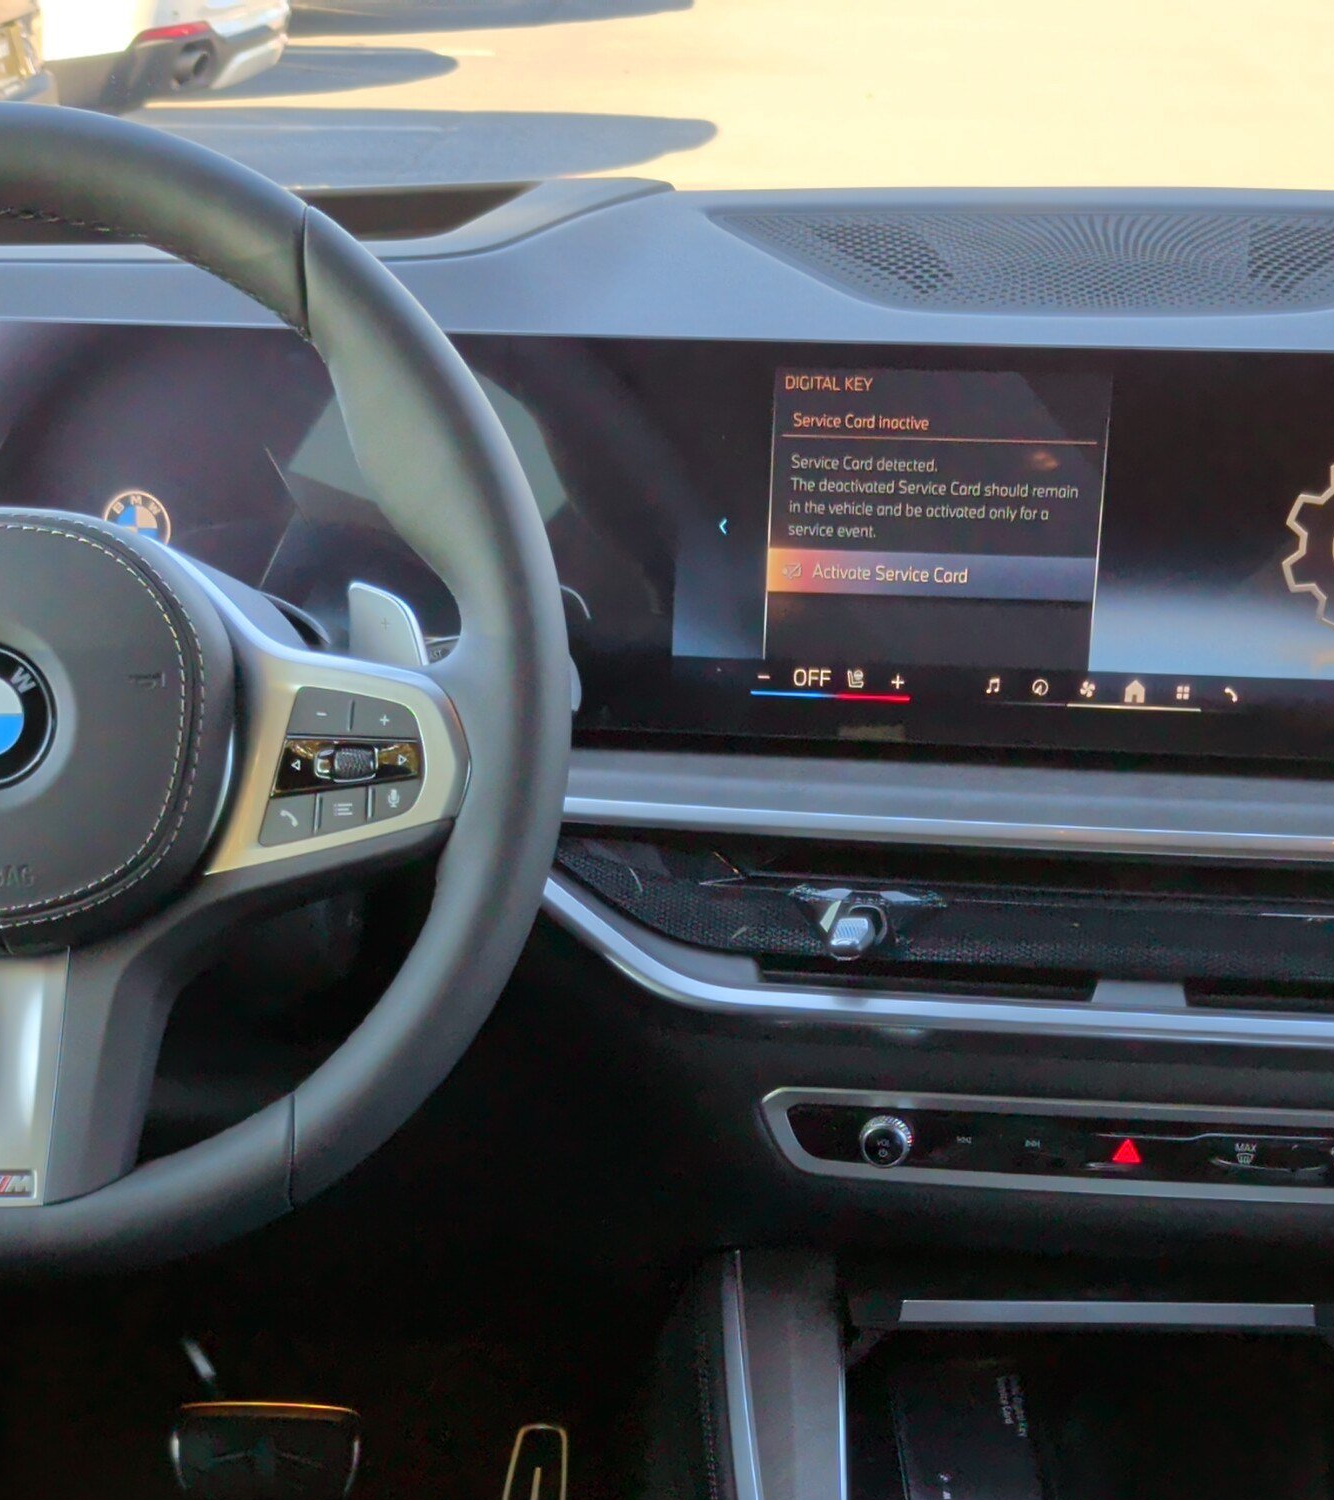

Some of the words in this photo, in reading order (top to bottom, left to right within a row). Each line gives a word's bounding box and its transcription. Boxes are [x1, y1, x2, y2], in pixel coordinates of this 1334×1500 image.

[785, 375, 840, 391] DIGITAL
[844, 377, 873, 392] KEY
[793, 412, 842, 428] Service
[845, 413, 875, 429] Card
[791, 455, 839, 470] Service
[843, 456, 873, 471] Card
[877, 457, 938, 473] detected.
[791, 478, 816, 493] The
[819, 478, 895, 495] deactivated
[898, 480, 946, 496] Service
[950, 481, 981, 497] Card
[984, 482, 1029, 498] should
[1032, 485, 1079, 499] remain
[788, 500, 801, 514] in
[804, 501, 825, 516] the
[828, 501, 873, 517] vehicle
[877, 502, 902, 518] and
[905, 503, 922, 518] be
[925, 503, 985, 520] activated
[988, 505, 1017, 525] only
[1020, 505, 1038, 521] for
[1040, 509, 1049, 521] a
[788, 523, 834, 538] service
[837, 526, 876, 539] event.
[812, 564, 871, 582] Activate
[875, 565, 929, 583] Service
[933, 566, 968, 584] Card
[793, 668, 832, 687] OFF
[1234, 1143, 1257, 1152] MAX
